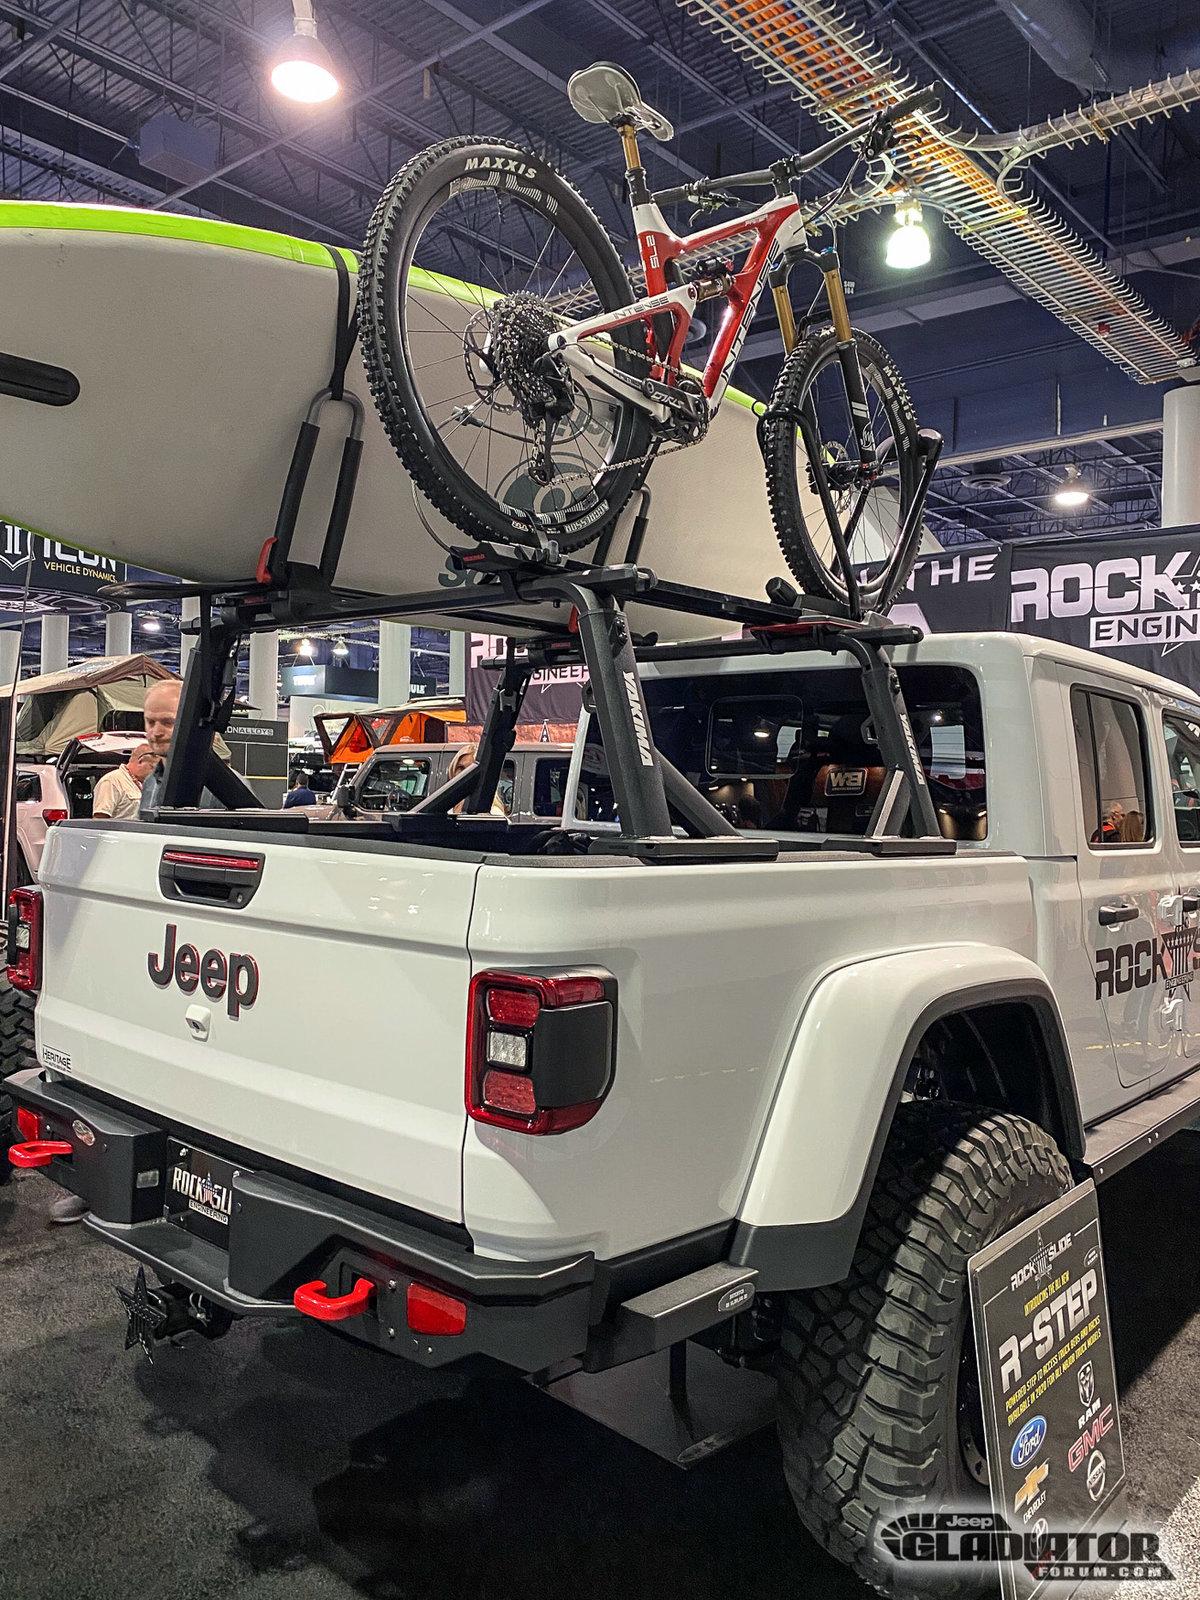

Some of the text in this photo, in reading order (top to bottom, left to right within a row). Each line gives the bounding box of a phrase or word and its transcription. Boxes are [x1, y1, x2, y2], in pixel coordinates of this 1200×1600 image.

[464, 156, 537, 179] MAXXIS
[612, 296, 669, 320] INTENSE
[721, 237, 780, 382] INTENSE
[883, 365, 913, 420] MAXXIS
[44, 561, 81, 575] VEHICLE
[1011, 551, 1191, 623] ROCK
[410, 684, 425, 694] ULE
[225, 726, 274, 736] ONALLOYS
[623, 671, 654, 767] YAKIMA
[900, 713, 925, 785] YAKIMA
[147, 923, 259, 1021] Jeep
[1096, 937, 1168, 1001] ROCK
[42, 1047, 72, 1070] HERITAGE
[172, 1166, 232, 1215] ROCK SLI
[190, 1200, 227, 1223] ENGINEERING
[1010, 1261, 1037, 1291] ROCK
[1048, 1232, 1073, 1262] SLIDE
[999, 1268, 1097, 1393] R-STEP
[1005, 1385, 1027, 1412] POWERED
[1026, 1374, 1037, 1391] STEP
[1043, 1354, 1058, 1376] ACCESS
[1058, 1341, 1071, 1361] TRUCK
[1071, 1332, 1081, 1349] BEDS
[1088, 1314, 1101, 1332] RACKS
[1008, 1398, 1030, 1427] AVAILABLE
[1035, 1381, 1047, 1399] 2020
[1047, 1373, 1055, 1388] FOR
[1062, 1352, 1075, 1374] MAJOR
[1075, 1340, 1087, 1360] TRUCK
[1087, 1328, 1101, 1349] MODELS
[1068, 1403, 1114, 1473] GMC
[1078, 1397, 1101, 1429] RAM
[1018, 1424, 1041, 1463] Ford
[1023, 1490, 1047, 1524] CHEVROLET
